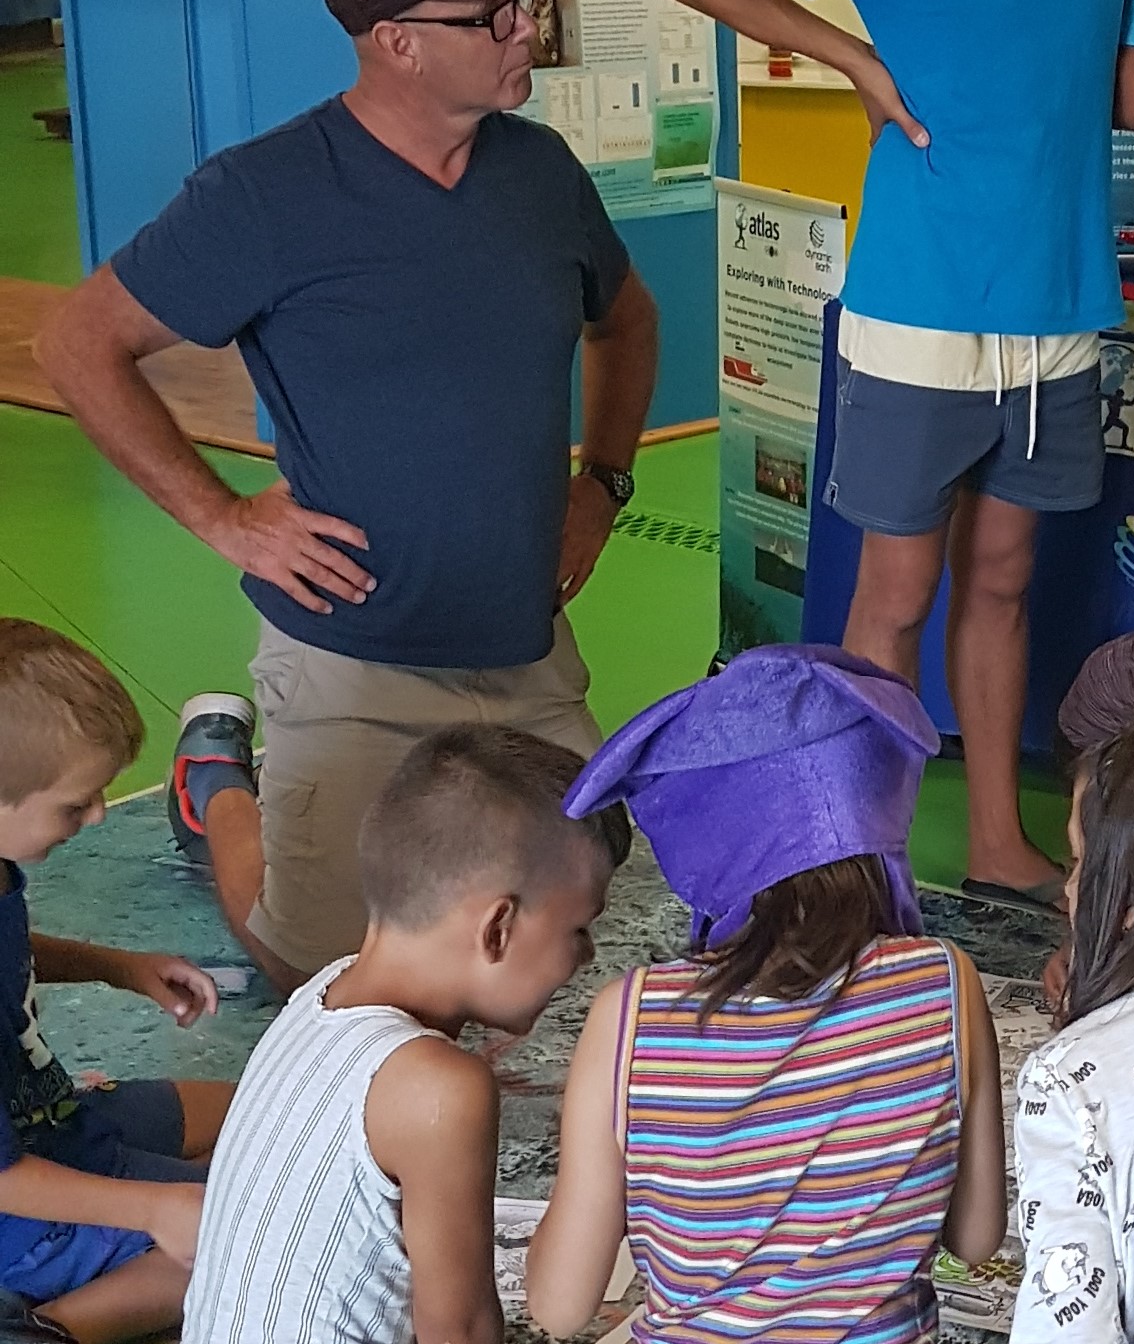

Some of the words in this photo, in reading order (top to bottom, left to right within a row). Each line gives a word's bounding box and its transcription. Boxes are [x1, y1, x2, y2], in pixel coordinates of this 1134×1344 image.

[749, 212, 780, 240] atlas
[804, 248, 832, 264] dynamic
[726, 264, 764, 288] Exploring
[767, 275, 786, 292] with
[1069, 1062, 1096, 1084] COOL
[1025, 1100, 1047, 1116] COOL
[1084, 1266, 1106, 1299] COOL
[1054, 1296, 1088, 1328] YOGA
